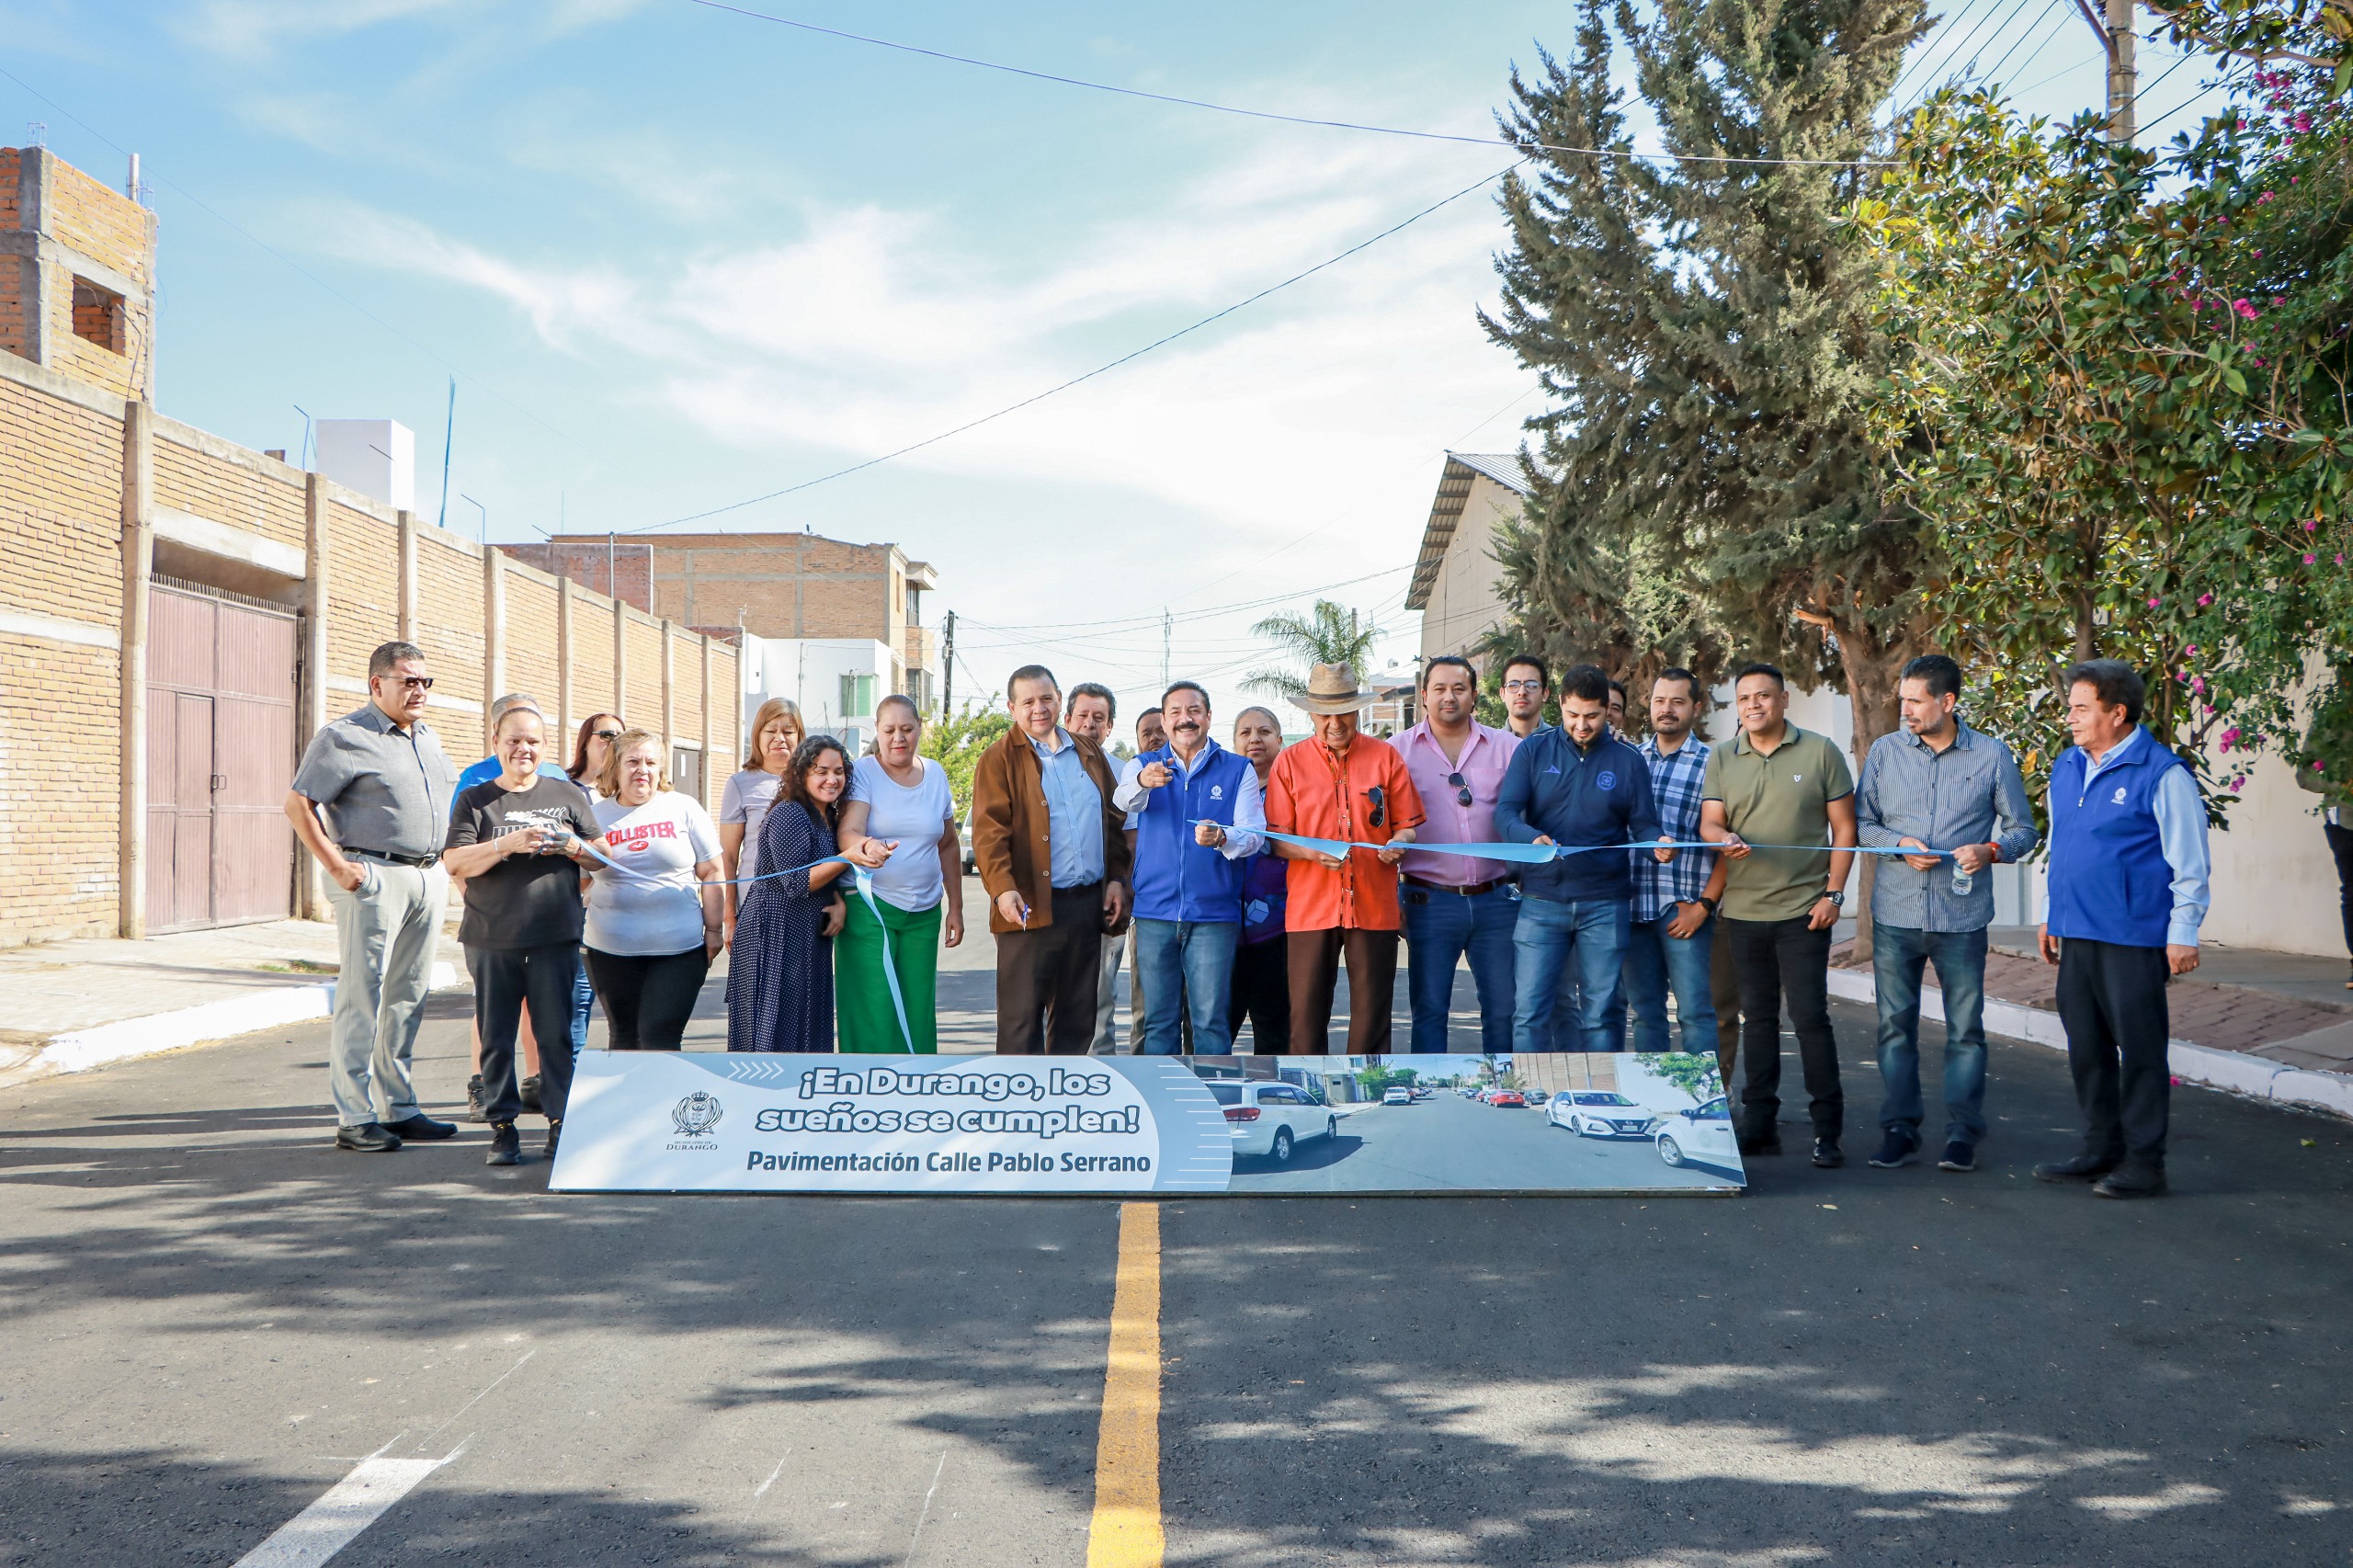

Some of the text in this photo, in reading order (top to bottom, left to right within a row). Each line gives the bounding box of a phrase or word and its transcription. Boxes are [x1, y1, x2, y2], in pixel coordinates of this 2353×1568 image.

[798, 1067, 1111, 1102] ¡En Durango, los
[755, 1101, 1140, 1140] sueños se cumplen!
[747, 1151, 1151, 1172] Pavimentación Calle Pablo Serrano
